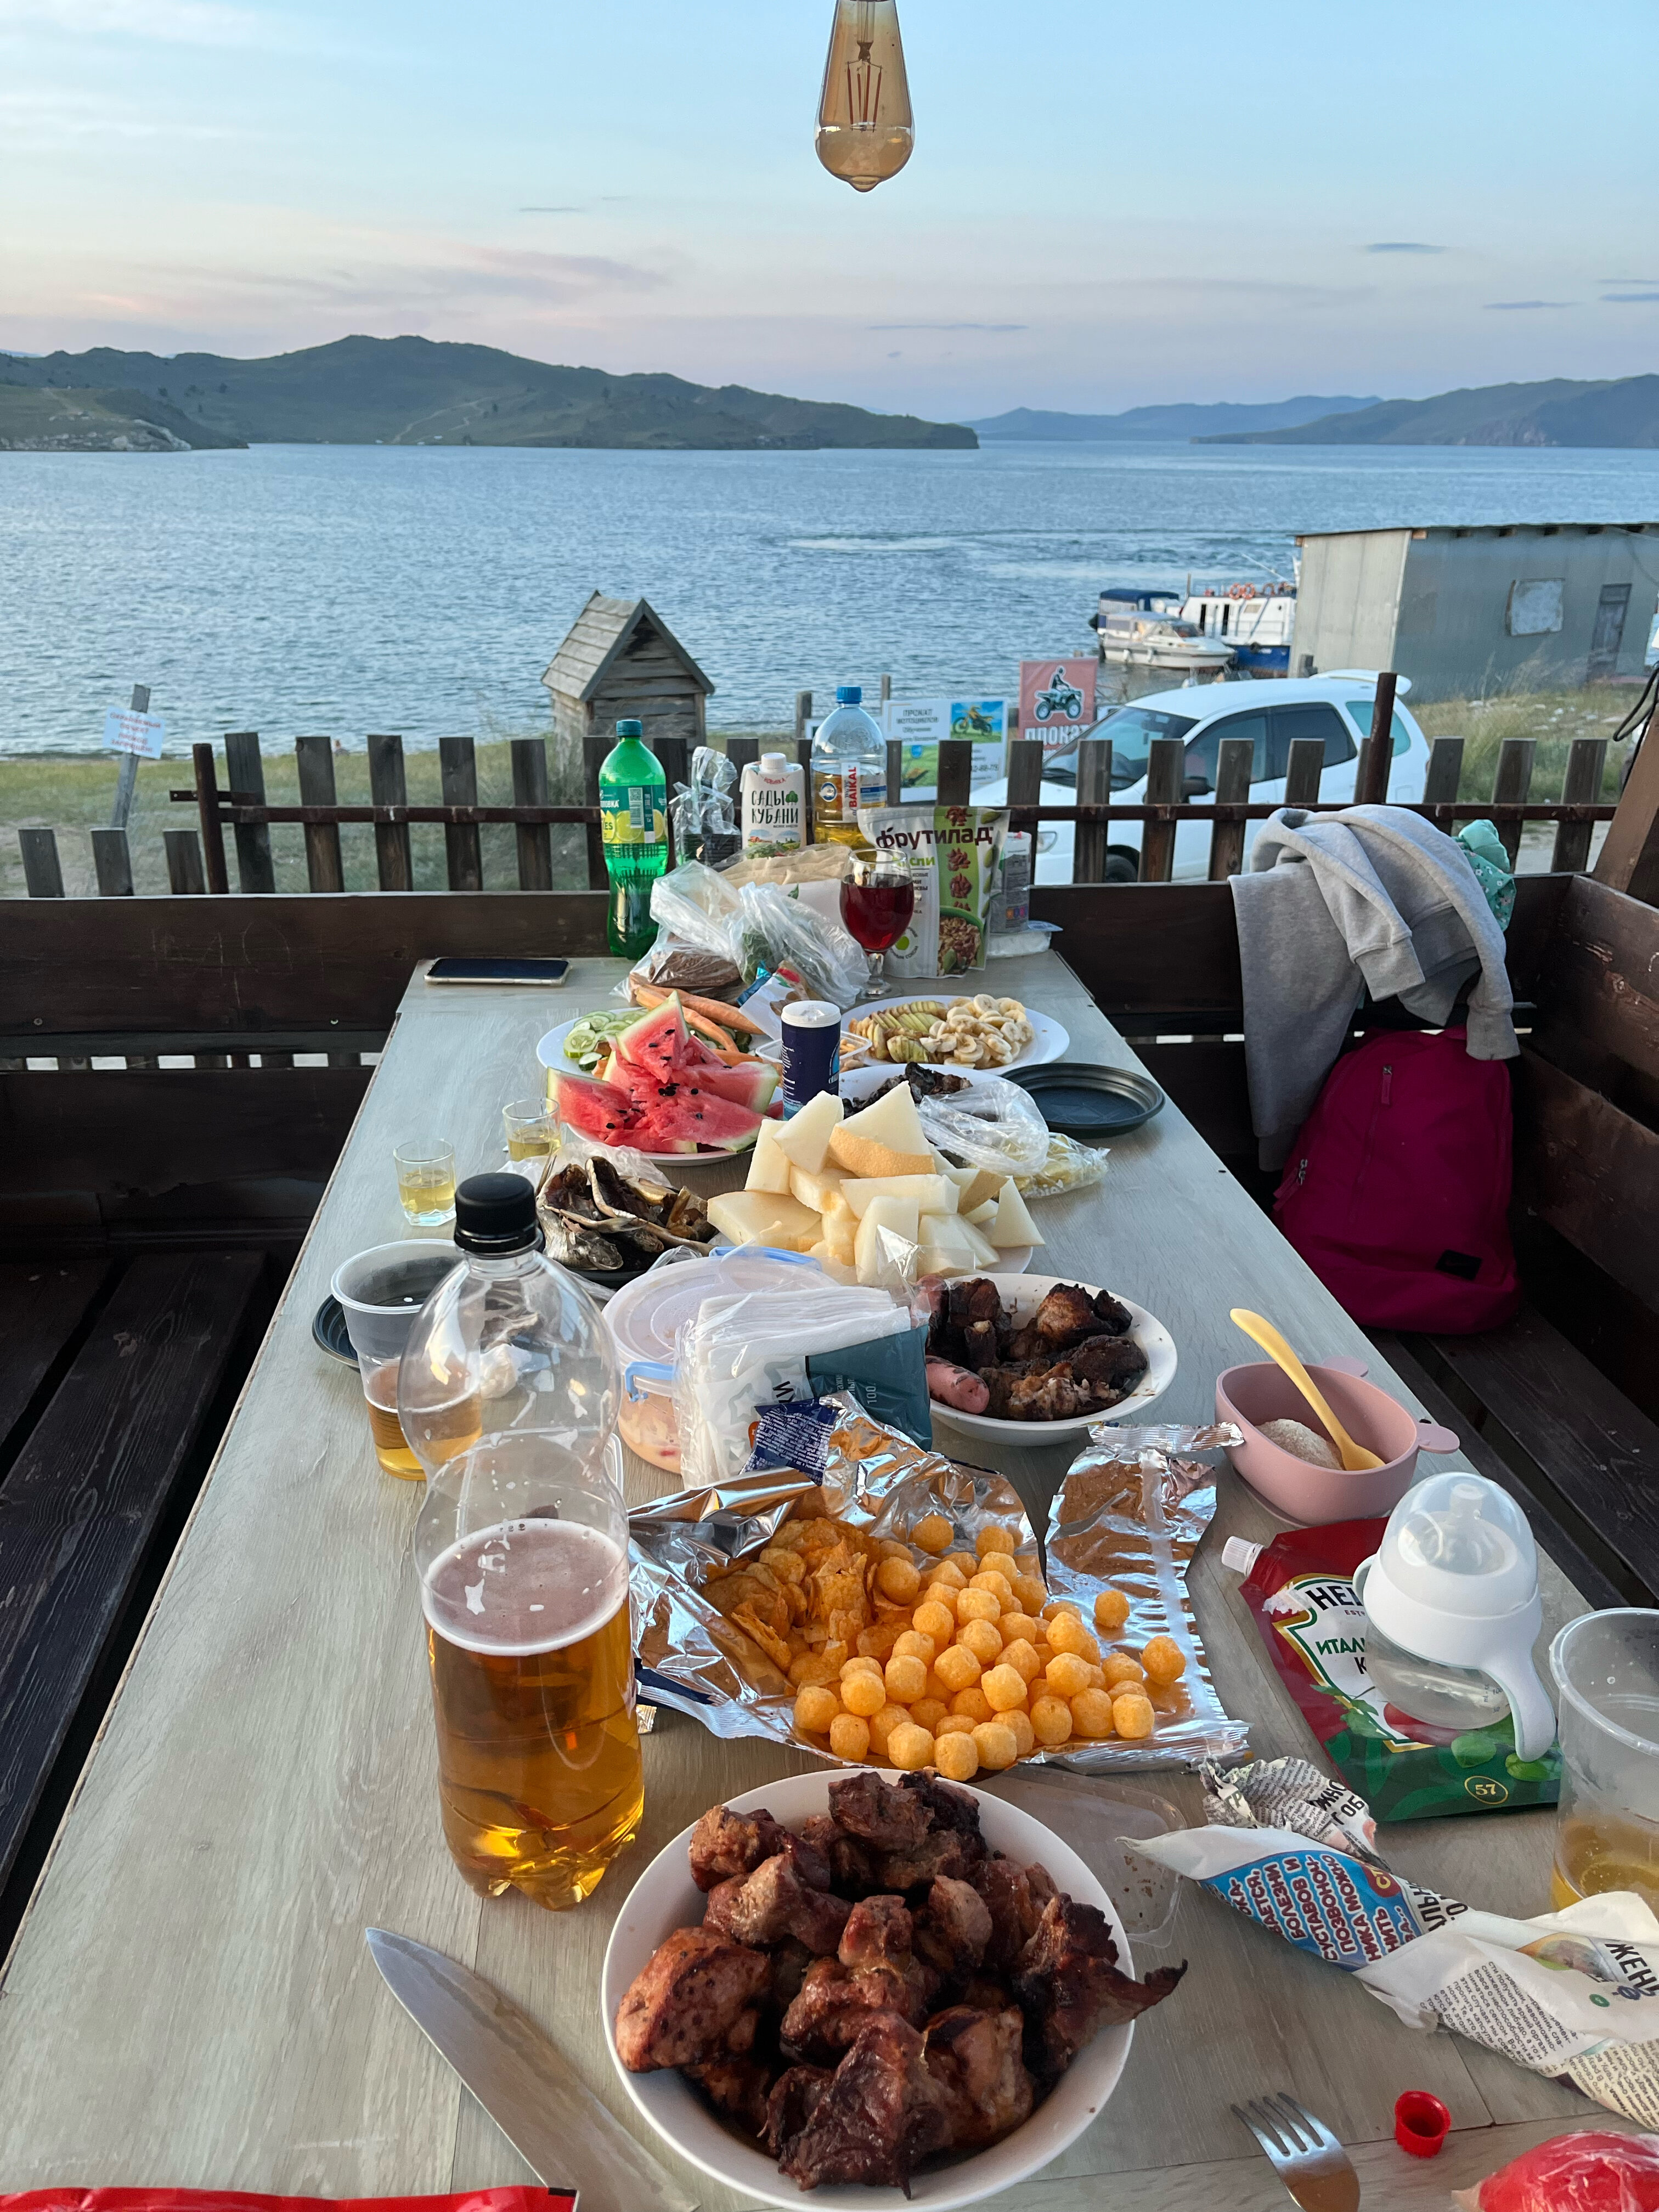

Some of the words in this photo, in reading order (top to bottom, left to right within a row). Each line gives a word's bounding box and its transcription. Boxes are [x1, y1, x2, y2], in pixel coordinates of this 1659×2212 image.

[752, 790, 785, 807] САДЫ
[848, 766, 857, 808] BAIKAL
[605, 822, 613, 830] ES
[752, 808, 798, 824] КУБАНИ
[1475, 1784, 1496, 1796] 57
[1284, 1858, 1300, 1871] И
[1323, 1855, 1361, 1912] МОЖНО
[1265, 1863, 1305, 1938] БОЛЕЗНИ
[1293, 1878, 1338, 1961] СУСТАВОВ
[1307, 1855, 1356, 1953] ПОЗВОНОЧ-
[1353, 1914, 1381, 1962] НИКА
[1434, 1994, 1447, 2013] ются
[1440, 1990, 1453, 2006] ется
[1454, 2013, 1471, 2036] этому
[1453, 1982, 1474, 2012] пропить
[1473, 2013, 1494, 2045] капсулы
[1460, 1977, 1473, 1994] этих
[1471, 1995, 1492, 2025] случаях
[1489, 2025, 1499, 2037] мы
[1466, 2018, 1476, 2031] кто
[1467, 1973, 1491, 2008] ниматься
[1508, 2039, 1516, 2050] Во
[1474, 1970, 1489, 1990] вовсе
[1491, 1997, 1528, 2052] неспособности
[1482, 1966, 1510, 2007] сниженном
[1507, 2008, 1527, 2038] либидо,
[1531, 2045, 1539, 2054] то
[1489, 1962, 1499, 1974] сти
[1497, 1974, 1518, 2007] получить
[1517, 2007, 1534, 2029] яркий
[1531, 2030, 1549, 2057] оргазм,
[1525, 2004, 1556, 2051] невозможно-
